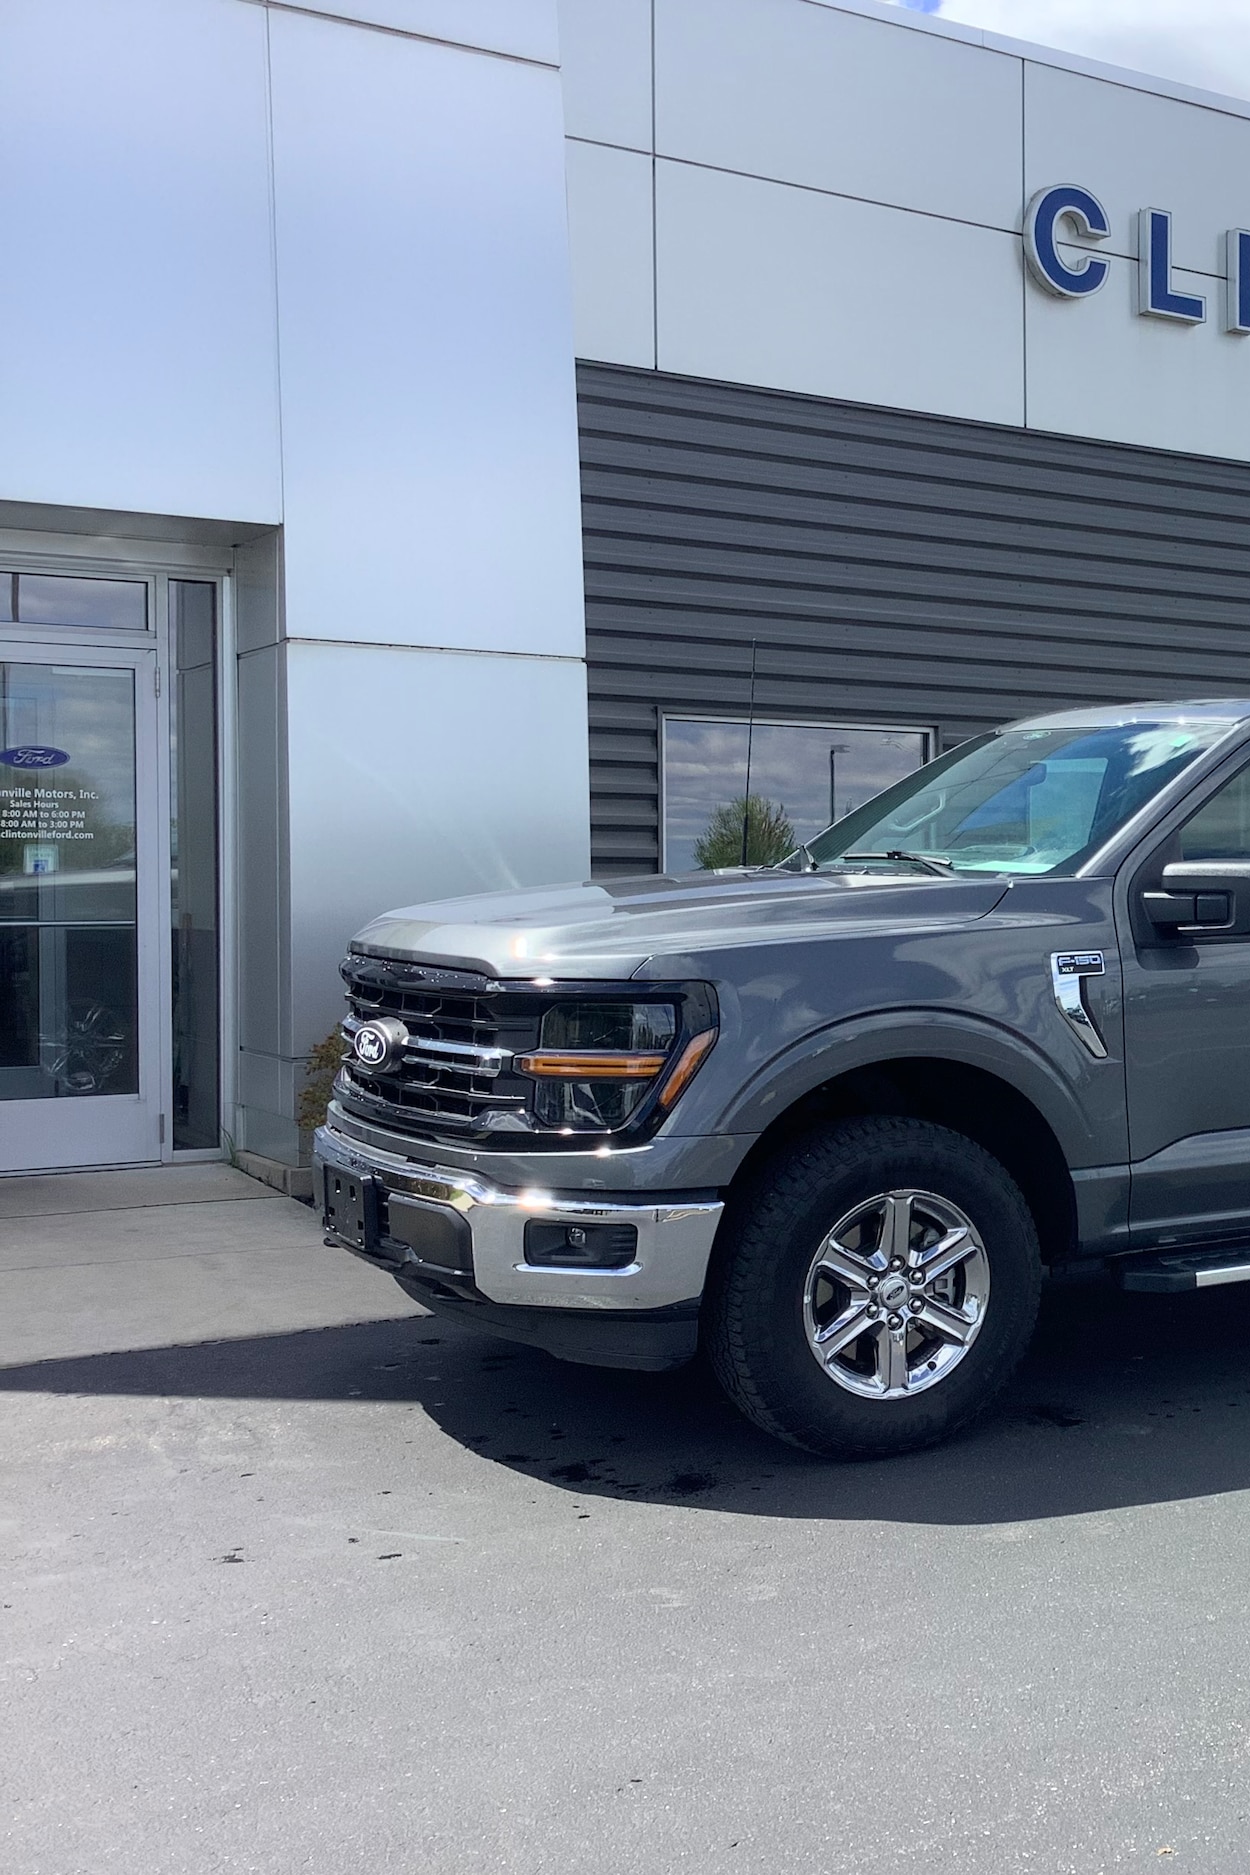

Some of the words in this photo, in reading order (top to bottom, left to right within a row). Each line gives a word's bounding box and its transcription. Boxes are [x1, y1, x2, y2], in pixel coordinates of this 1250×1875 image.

[13, 748, 55, 765] Ford
[0, 787, 32, 799] nville
[34, 788, 77, 800] Motors,
[79, 789, 99, 800] Inc.
[10, 799, 32, 808] Sales
[33, 800, 59, 809] Hours
[2, 809, 21, 818] 8:00
[22, 810, 38, 818] AM
[40, 810, 50, 819] to
[51, 810, 70, 819] 6:00
[71, 811, 86, 819] PM
[0, 819, 19, 828] 8:00
[21, 820, 36, 828] AM
[38, 820, 48, 828] to
[49, 820, 68, 829] 3:00
[70, 820, 84, 829] PM
[1058, 954, 1102, 966] F-150
[360, 1031, 380, 1060] Ford
